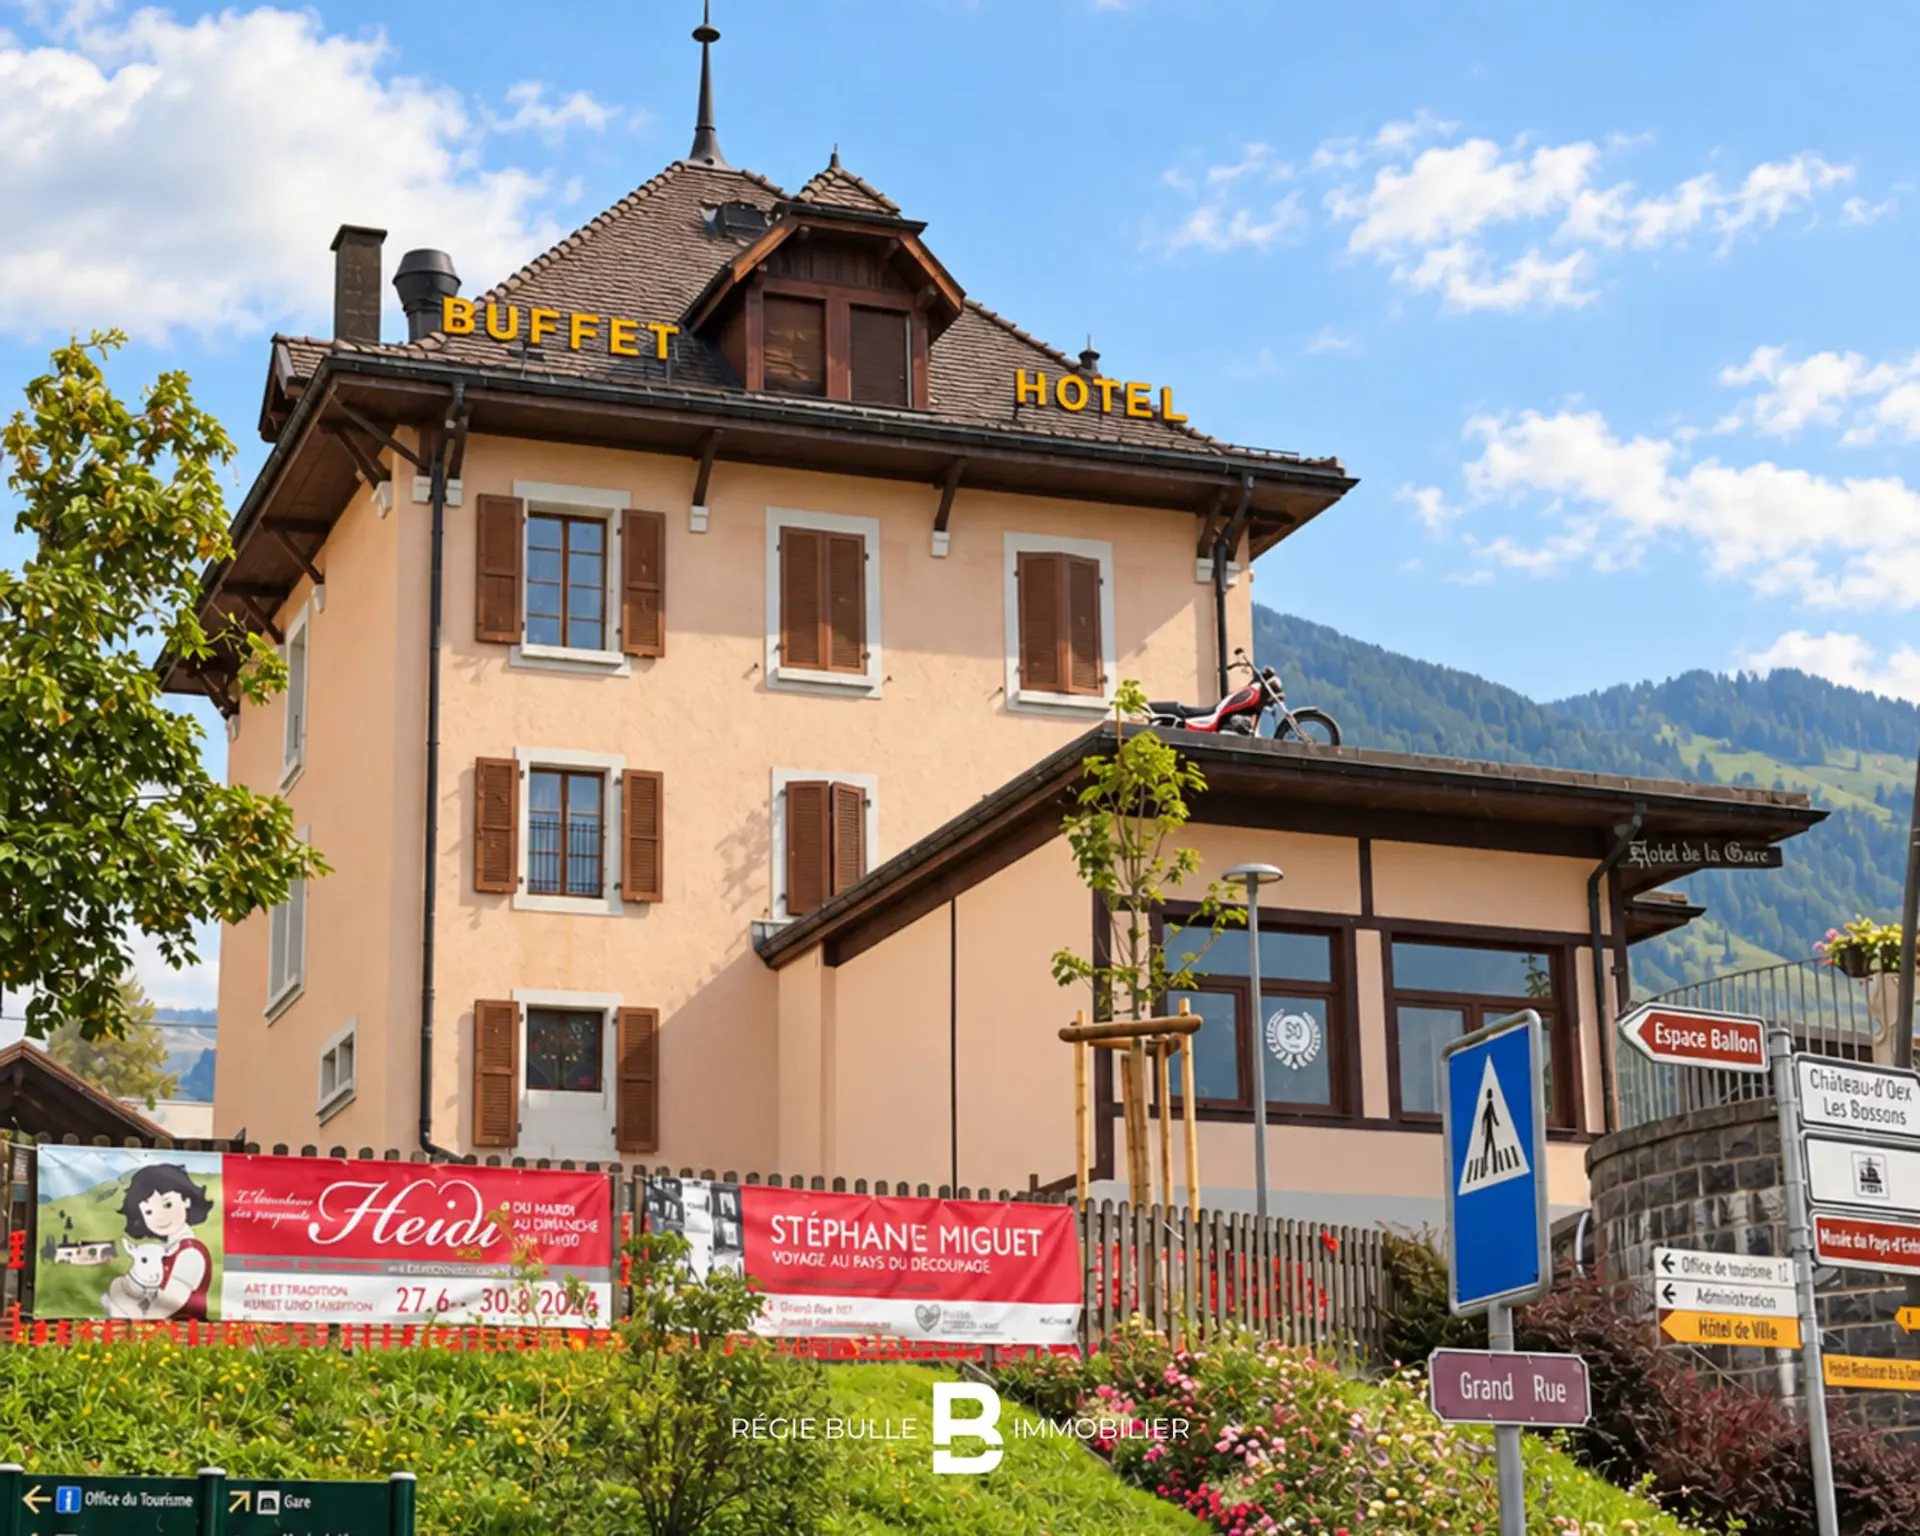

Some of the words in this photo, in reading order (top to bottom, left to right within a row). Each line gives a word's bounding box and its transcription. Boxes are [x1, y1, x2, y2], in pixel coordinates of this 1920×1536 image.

[442, 296, 680, 360] BUFFET
[1015, 367, 1188, 423] HOTEL
[1628, 840, 1679, 868] Hotel
[1683, 842, 1701, 863] de
[1704, 842, 1721, 863] la
[1724, 841, 1769, 864] Gare
[1655, 1022, 1707, 1051] Espace
[1711, 1028, 1758, 1053] Ballon
[1823, 1096, 1847, 1118] Les
[1850, 1099, 1907, 1125] Bossons
[308, 1179, 503, 1247] Heidi
[512, 1201, 532, 1214] DU
[534, 1203, 576, 1217] MARDI
[512, 1218, 531, 1231] AU
[533, 1219, 599, 1233] DIMANCHE
[771, 1211, 927, 1253] STÉPHANE
[939, 1225, 1043, 1257] MIGUET
[772, 1251, 825, 1267] VOYAGE
[830, 1254, 849, 1268] AU
[853, 1255, 885, 1270] PAYS
[888, 1257, 908, 1271] DU
[1681, 1256, 1712, 1275] Office
[1714, 1261, 1727, 1277] de
[244, 1284, 268, 1294] ART
[270, 1284, 284, 1295] ET
[1696, 1288, 1777, 1309] Administration
[1735, 1321, 1750, 1339] de
[1752, 1321, 1778, 1340] Ville
[1459, 1371, 1514, 1400] Grand
[1533, 1375, 1566, 1402] Rue
[85, 1491, 119, 1507] Office
[121, 1492, 138, 1507] du
[140, 1492, 194, 1508] Tourisme
[284, 1495, 311, 1510] Gare
